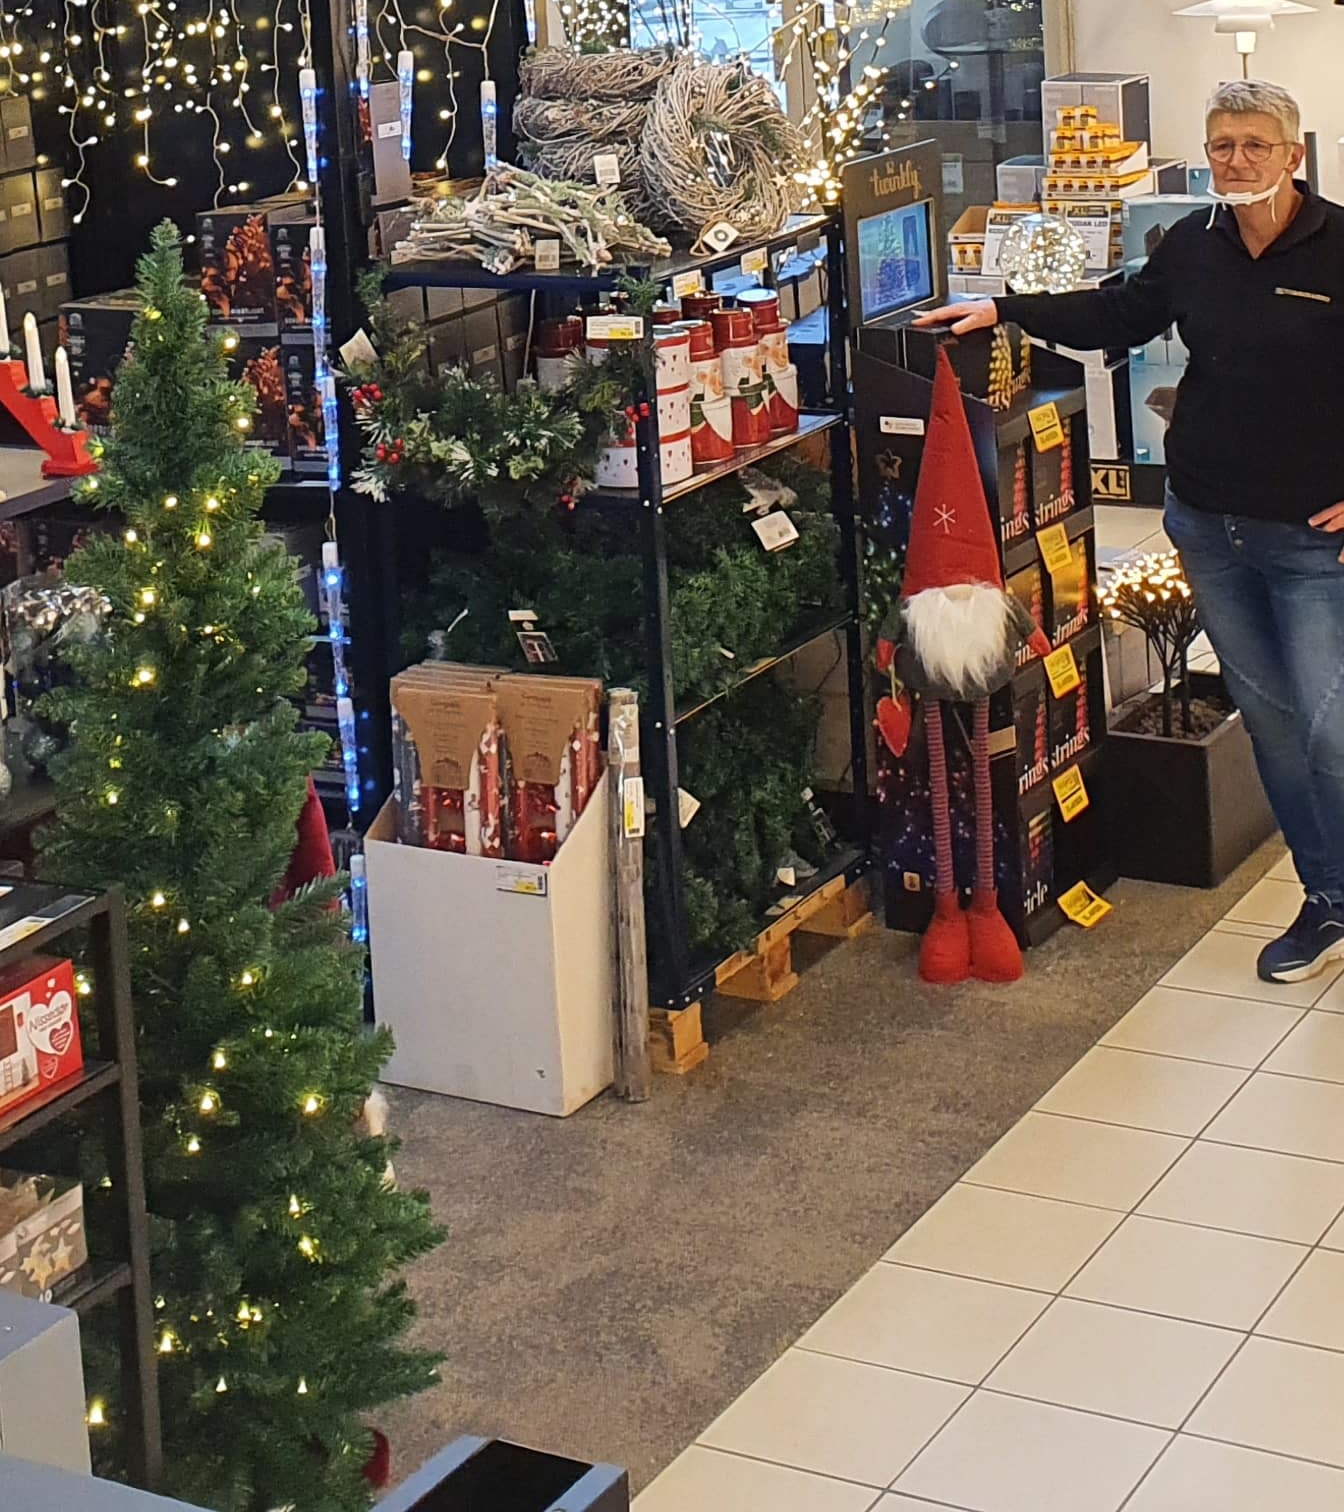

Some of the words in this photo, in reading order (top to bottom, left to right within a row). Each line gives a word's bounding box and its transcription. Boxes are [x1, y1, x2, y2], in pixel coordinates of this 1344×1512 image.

[870, 160, 923, 199] twinkly
[1000, 510, 1030, 542] ings
[1018, 755, 1049, 796] rings
